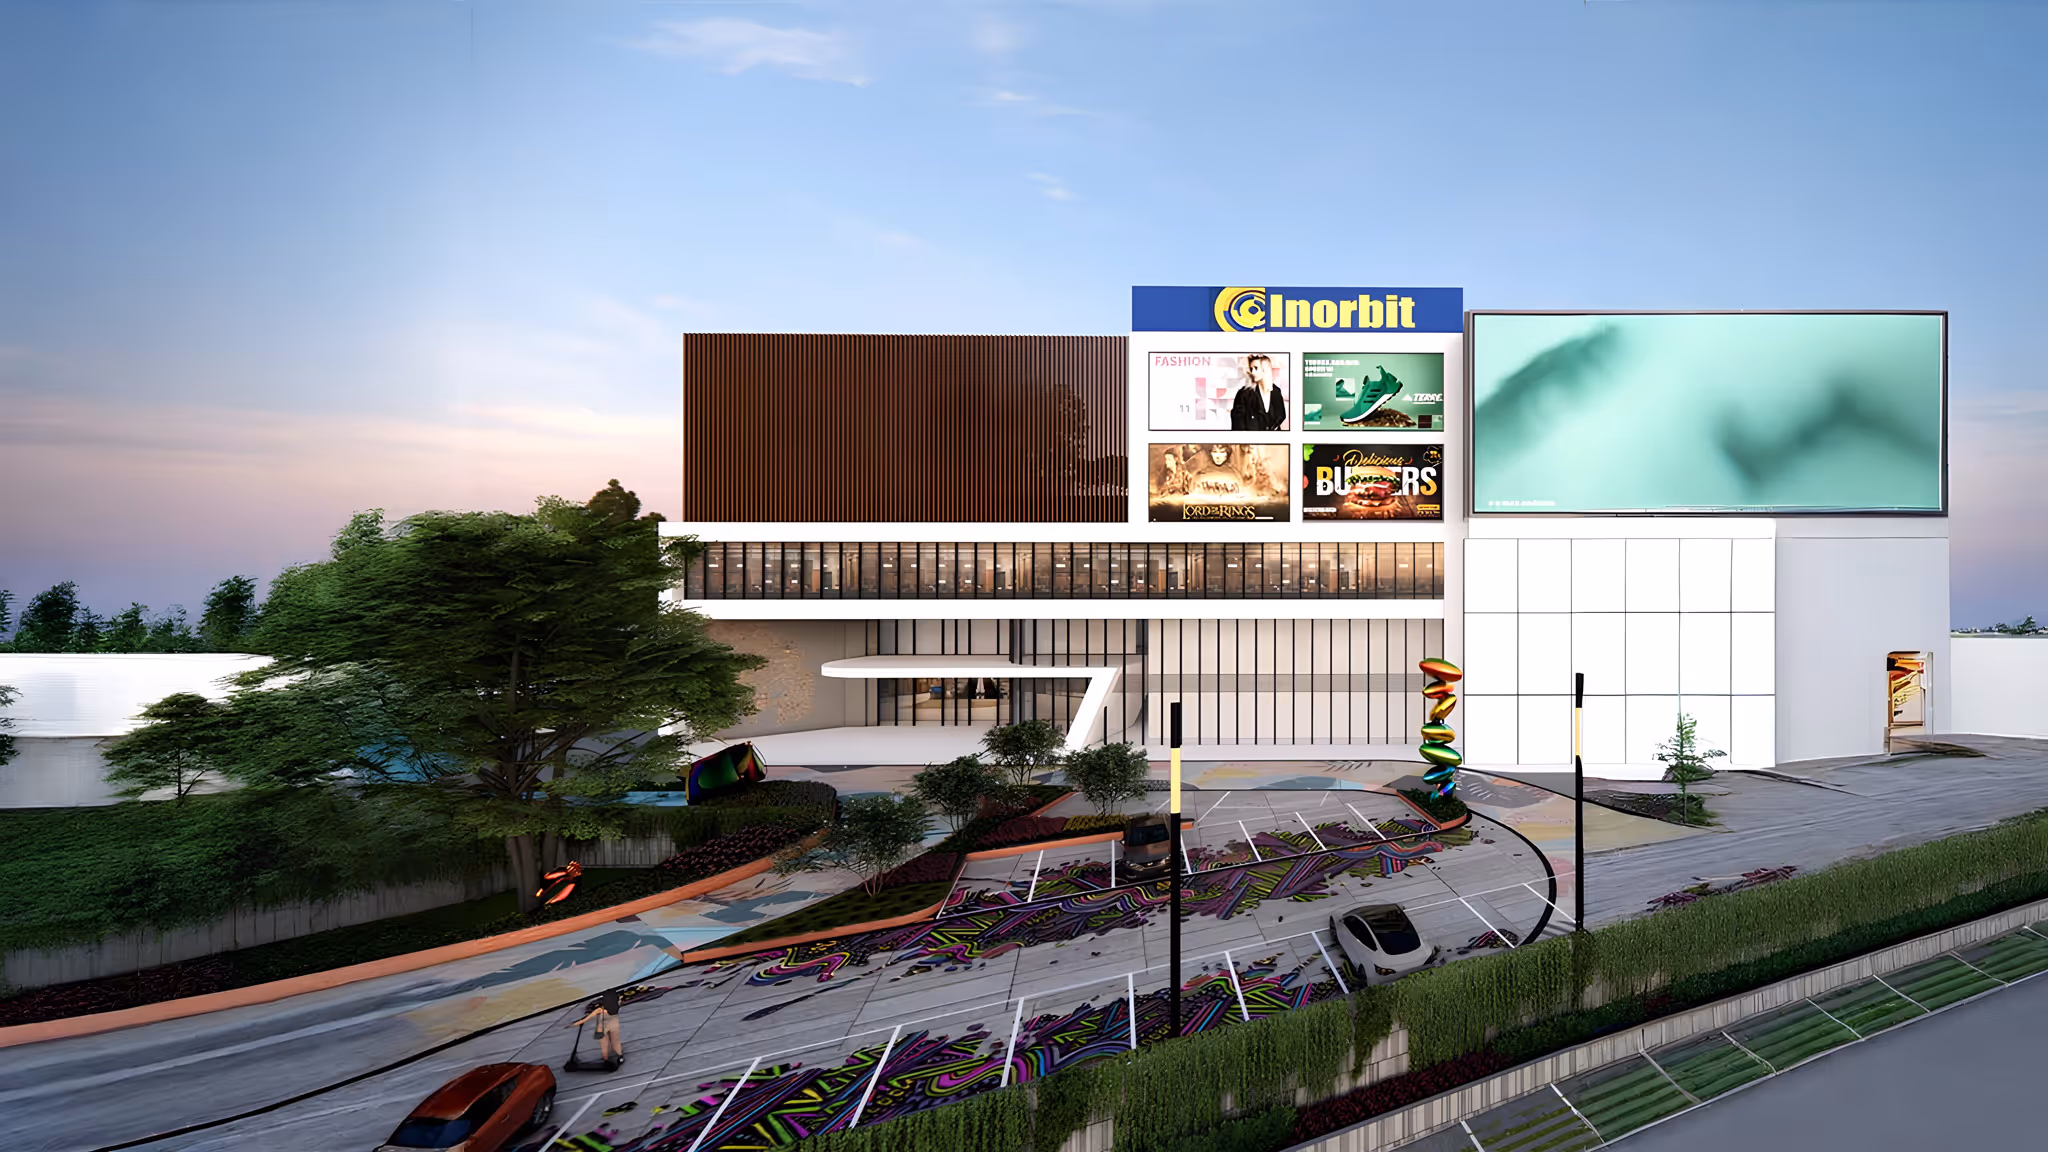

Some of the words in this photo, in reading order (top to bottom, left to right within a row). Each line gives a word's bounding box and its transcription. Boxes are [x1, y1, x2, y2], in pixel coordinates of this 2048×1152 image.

[1270, 294, 1416, 328] Inorbit
[1155, 356, 1211, 367] FASHION
[1342, 449, 1405, 466] Delicious
[1316, 466, 1438, 496] BUERS
[1183, 503, 1211, 520] LORD
[1219, 505, 1256, 520] RINGS
